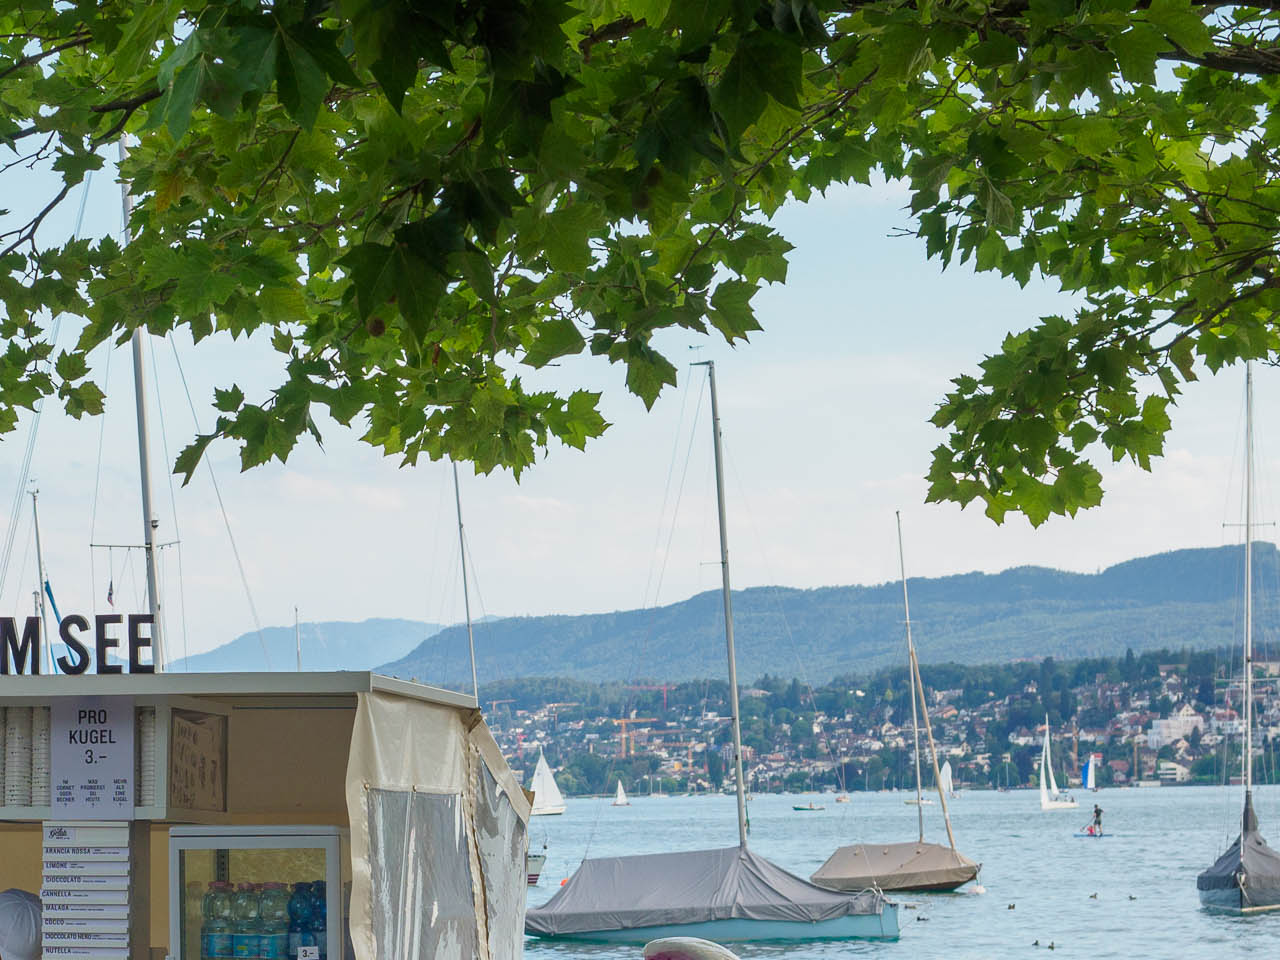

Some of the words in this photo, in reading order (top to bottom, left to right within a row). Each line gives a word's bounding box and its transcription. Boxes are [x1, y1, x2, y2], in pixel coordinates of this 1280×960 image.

[57, 613, 155, 675] SEE
[78, 709, 107, 724] PRO
[69, 729, 116, 745] KUGEL
[45, 875, 81, 883] CIOCCOLATO
